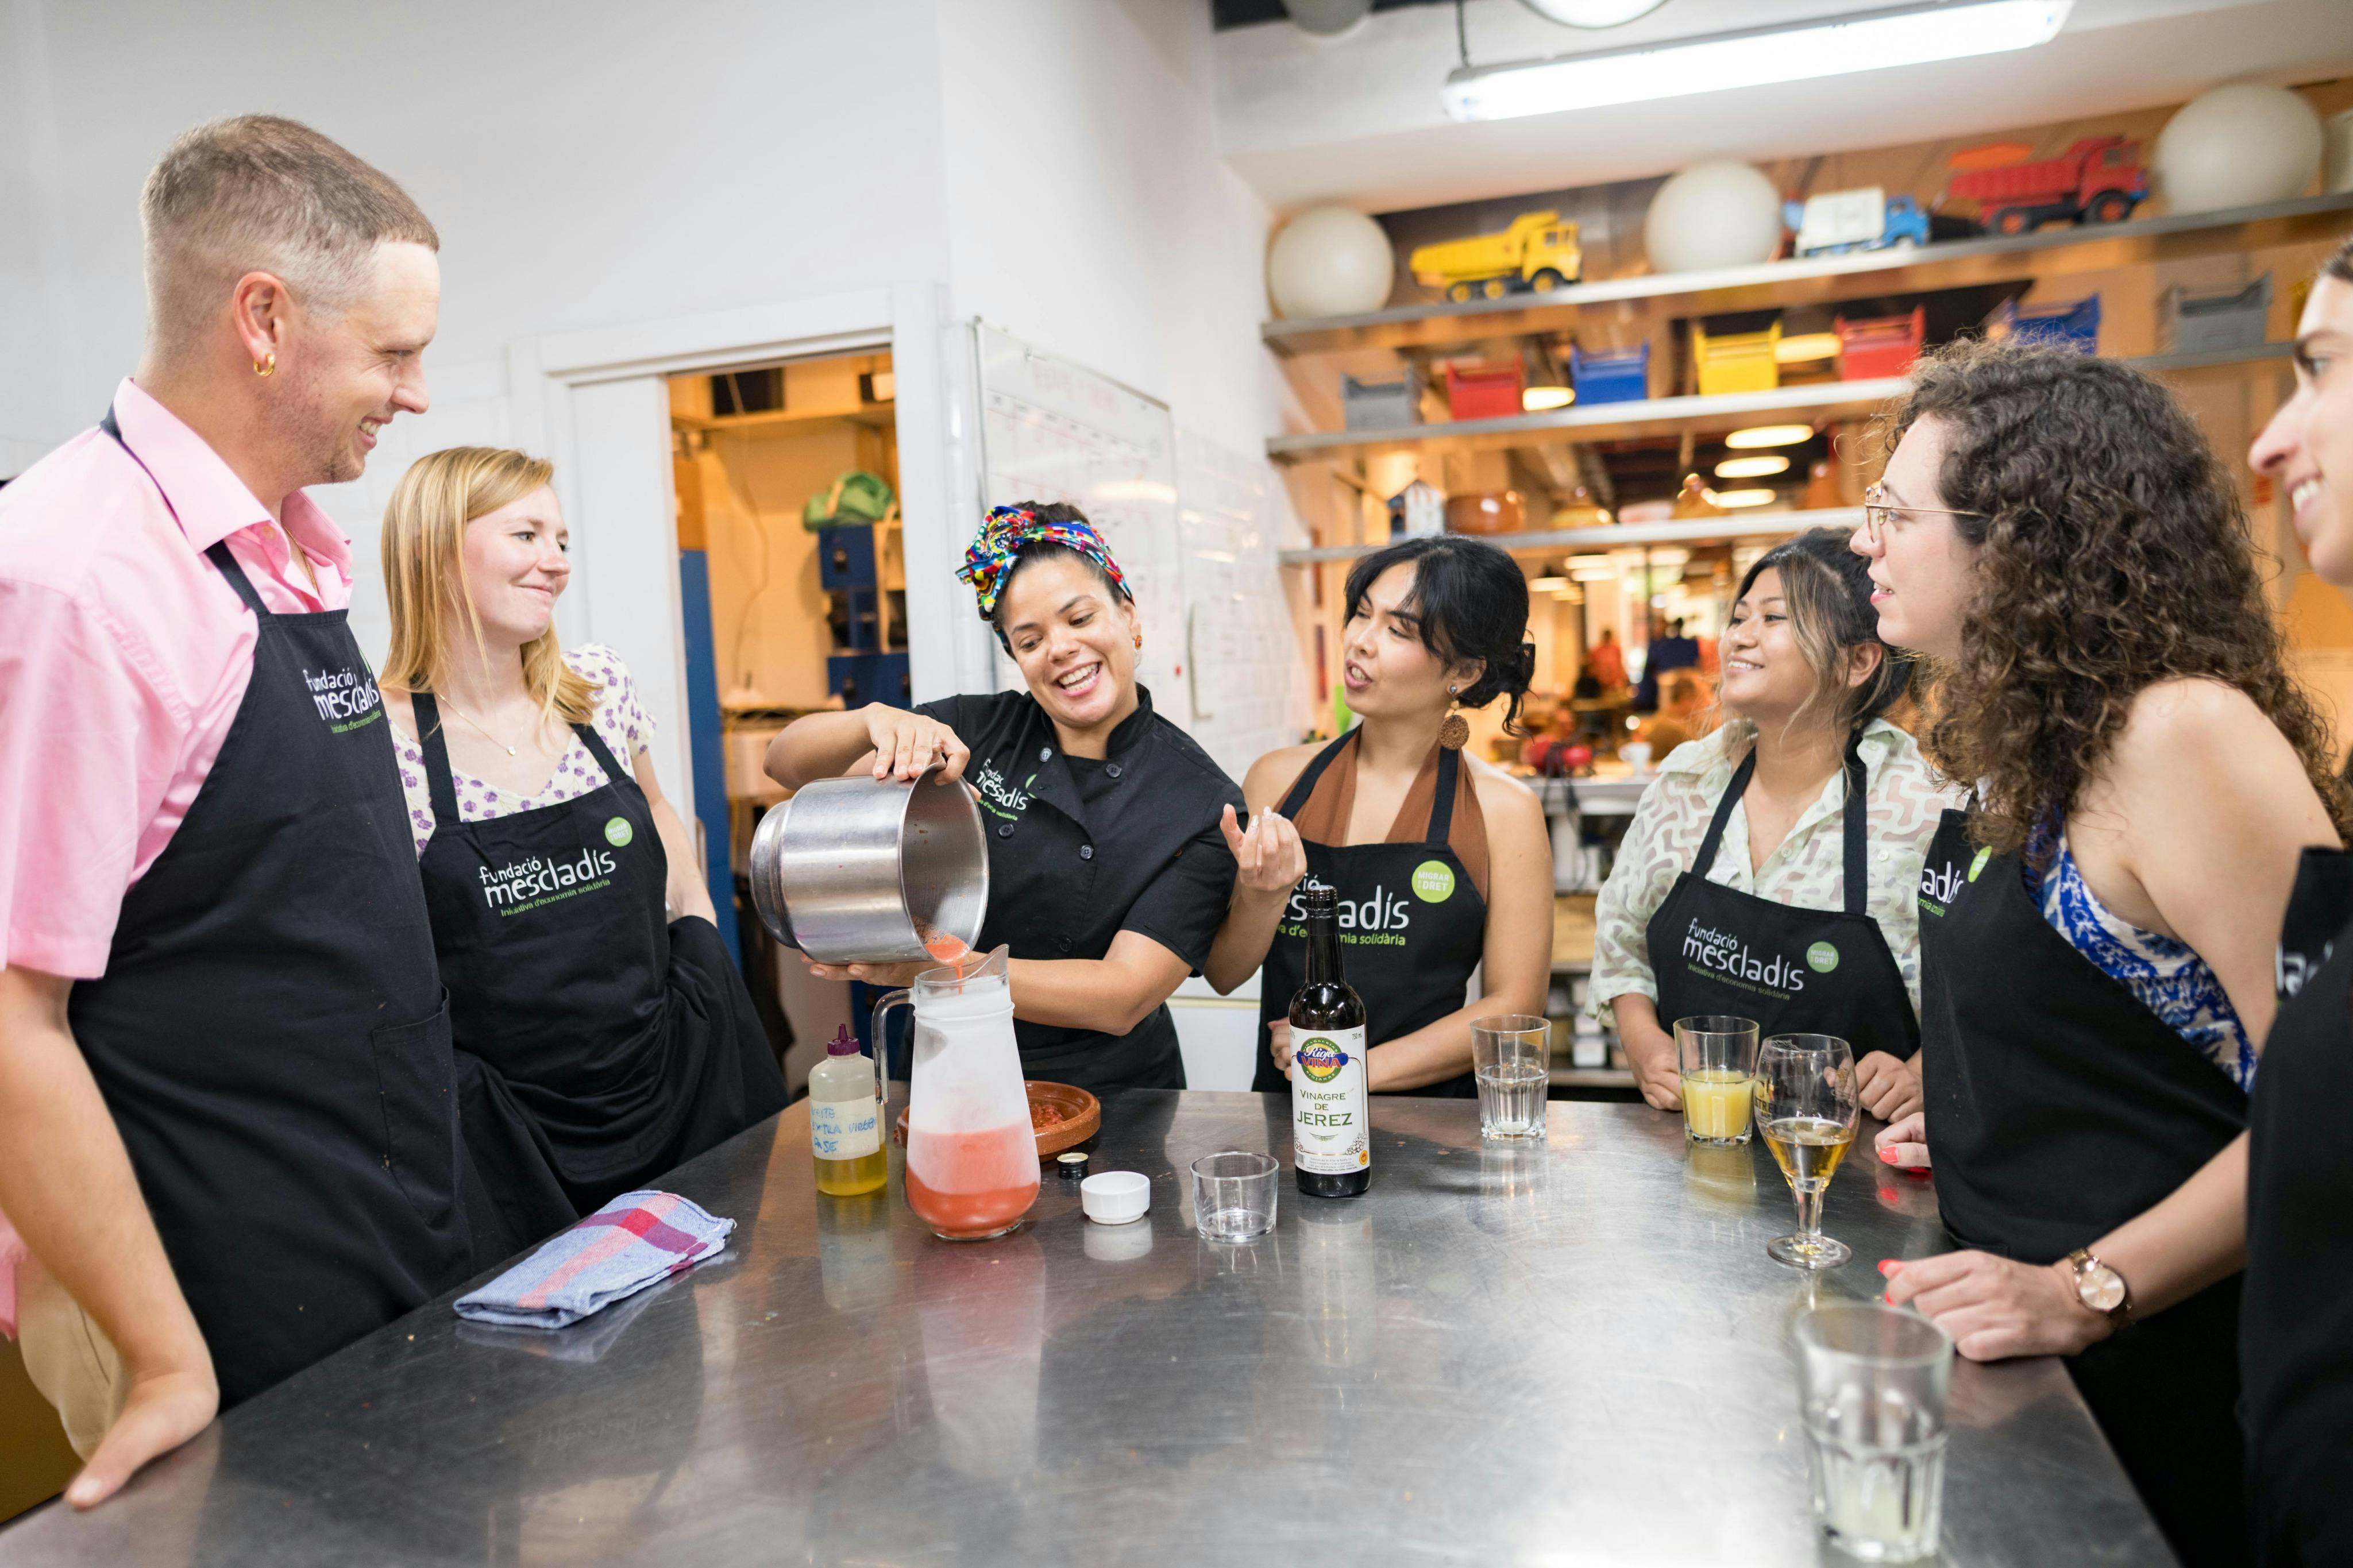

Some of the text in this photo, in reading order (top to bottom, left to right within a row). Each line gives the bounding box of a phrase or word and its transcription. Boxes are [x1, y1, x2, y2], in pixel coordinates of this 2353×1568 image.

[479, 856, 542, 885] fundació
[484, 848, 616, 908] mescladís
[1418, 871, 1449, 882] MIGRAR
[1422, 880, 1448, 892] DRET
[1359, 933, 1406, 946] solidària
[1688, 917, 1738, 951] fundació
[1683, 936, 1804, 991] mescladís
[1688, 963, 1715, 979] Iniciativa
[1716, 974, 1757, 992] d'economia
[1300, 1089, 1346, 1101] VINAGRE
[1314, 1103, 1329, 1111] DE
[1297, 1111, 1352, 1127] JEREZ
